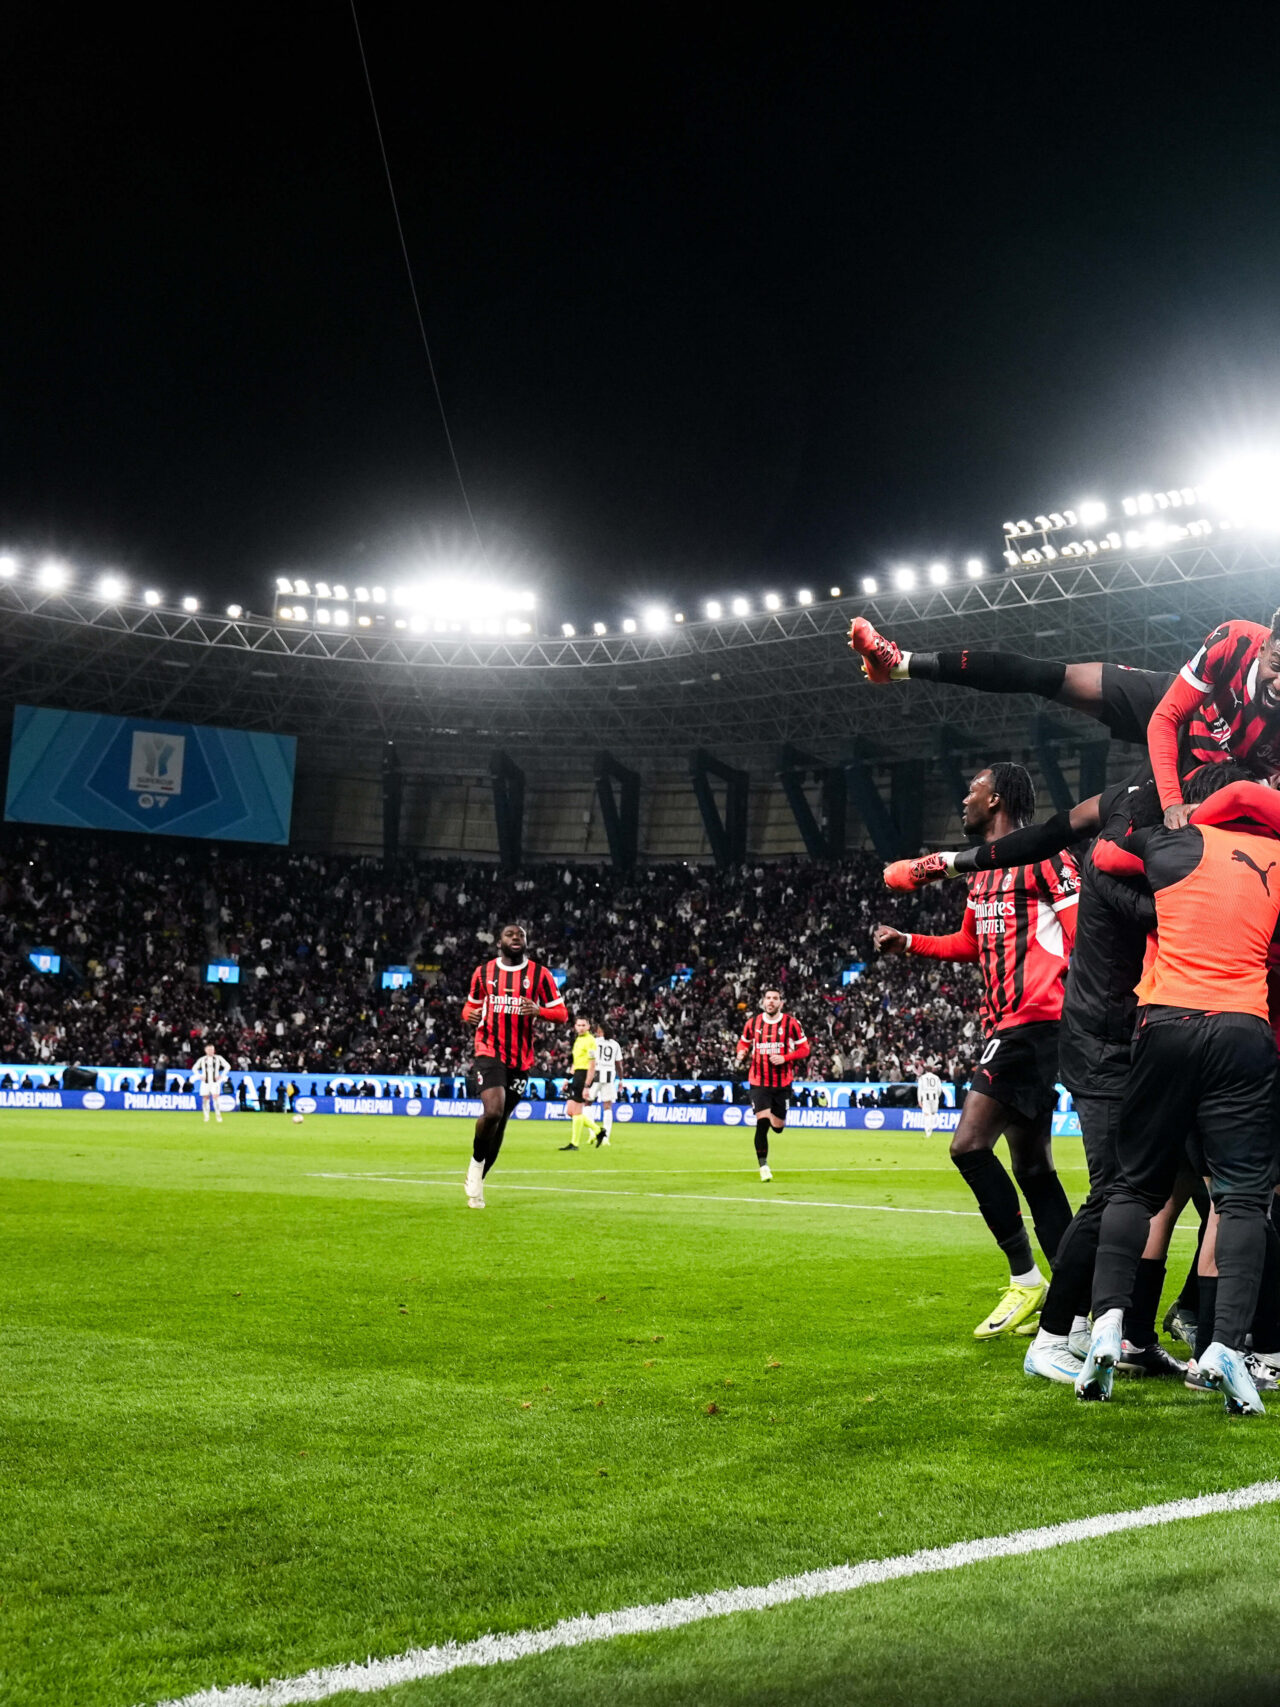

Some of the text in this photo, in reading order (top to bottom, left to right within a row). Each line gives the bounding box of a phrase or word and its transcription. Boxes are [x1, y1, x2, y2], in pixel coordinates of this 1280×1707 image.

[1057, 876, 1082, 894] MSC
[975, 900, 1016, 918] mirates
[598, 1044, 614, 1062] 19
[925, 1077, 937, 1088] 10
[0, 1091, 63, 1108] ILADELPHIA
[123, 1092, 197, 1110] PHILADELPHIA
[334, 1097, 393, 1115] PHILADELPHIA
[647, 1105, 707, 1123] PHILADELPHIA
[785, 1109, 847, 1128] HILADELPHIA
